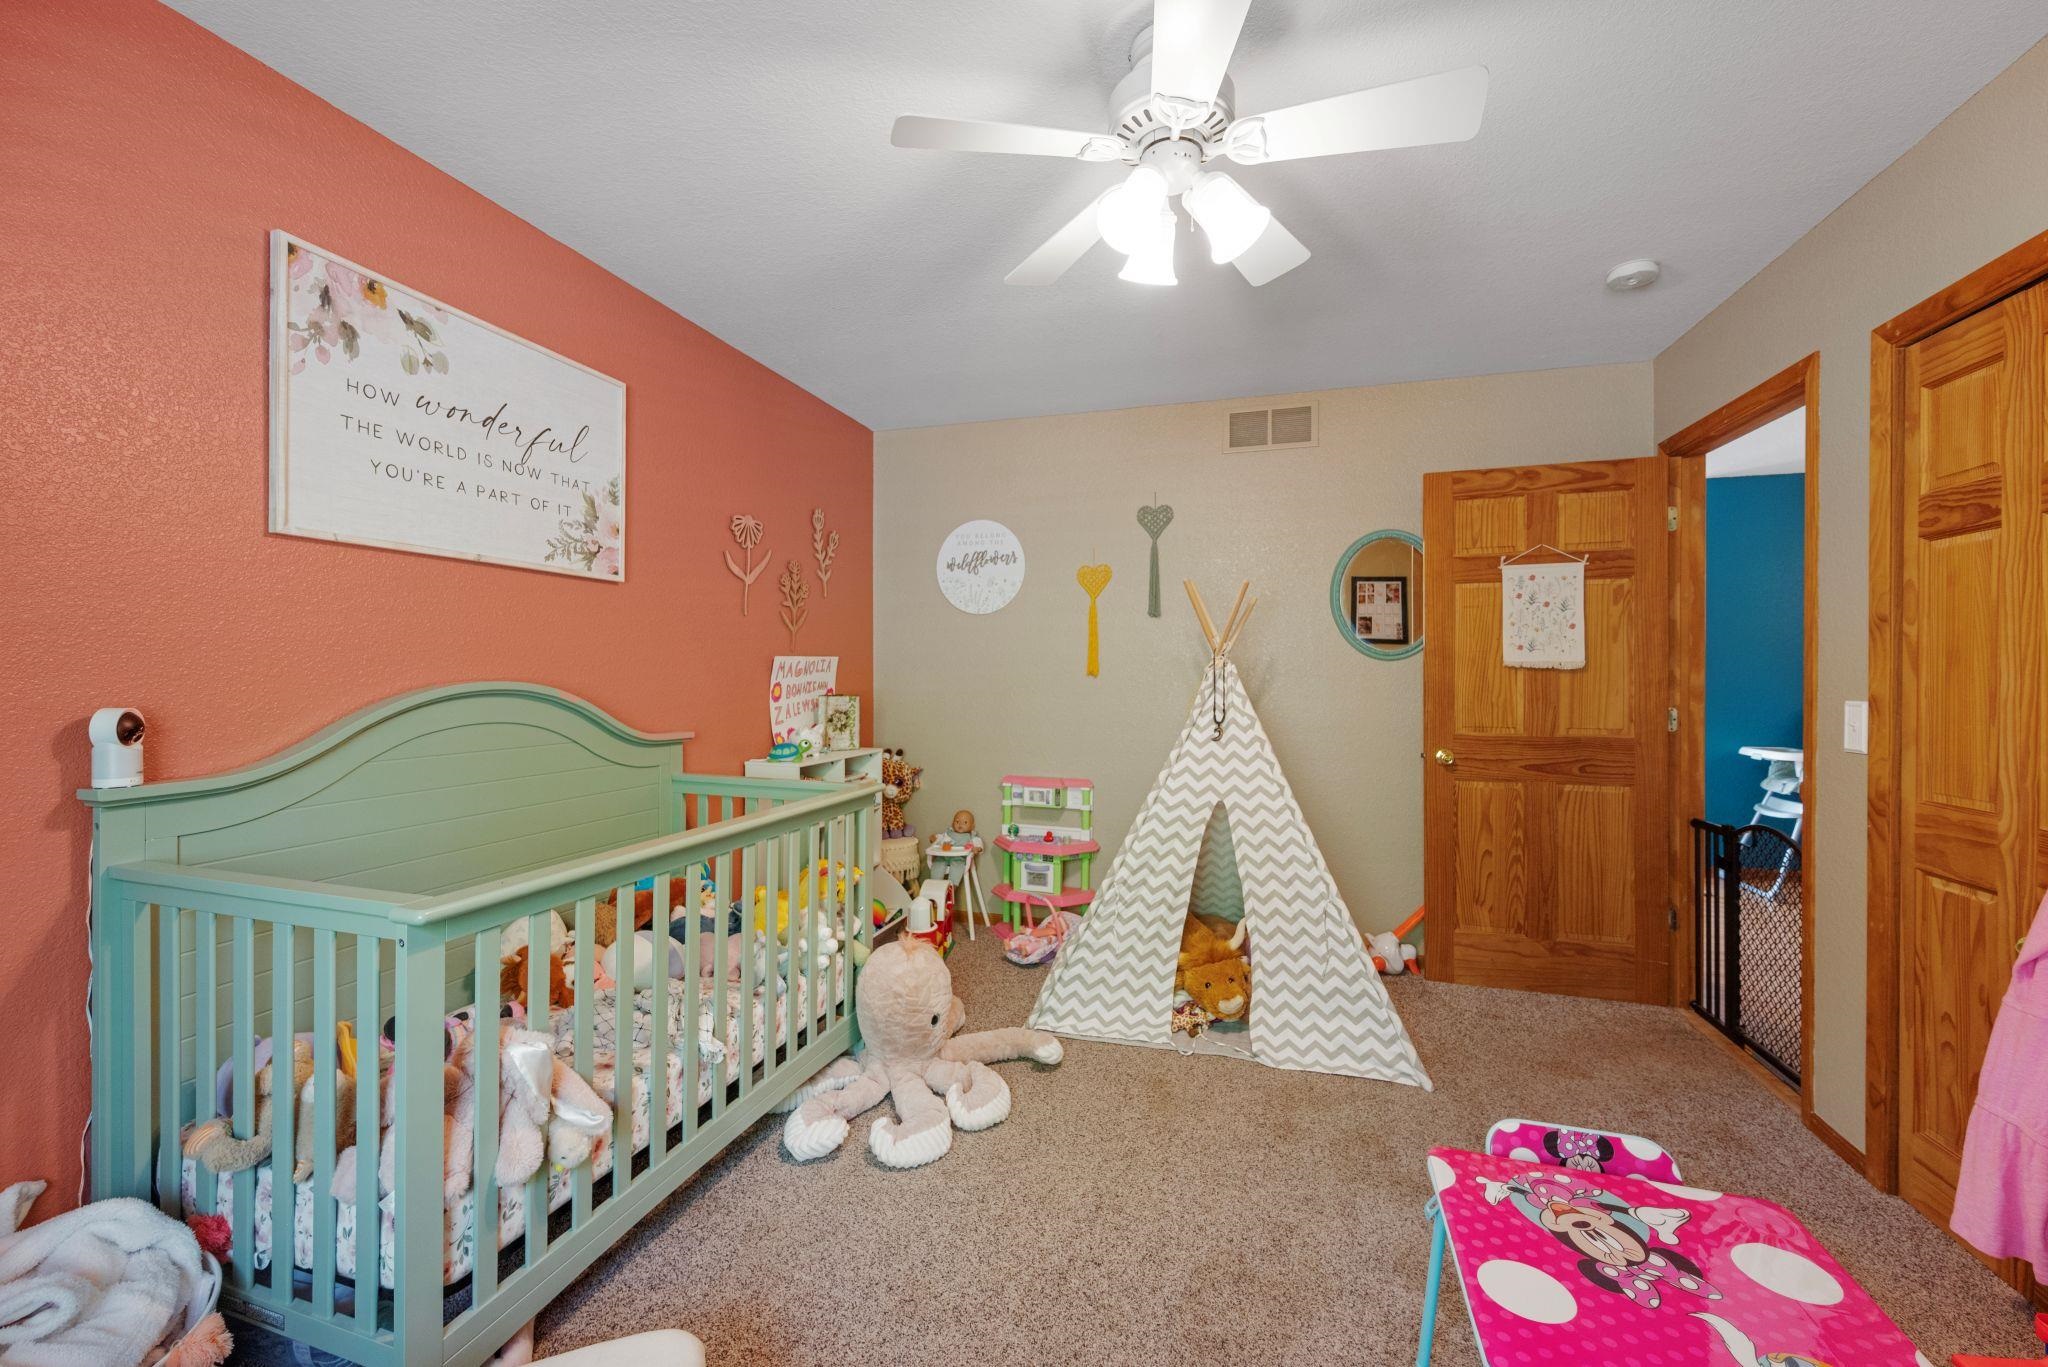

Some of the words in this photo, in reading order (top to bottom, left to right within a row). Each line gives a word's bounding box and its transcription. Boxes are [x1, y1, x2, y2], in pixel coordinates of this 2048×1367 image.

[346, 378, 401, 407] HOW
[416, 394, 590, 463] wonderful
[341, 414, 383, 440] THE
[396, 428, 467, 461] WORLD
[477, 452, 493, 468] IS
[502, 459, 541, 480] NOW
[550, 472, 591, 491] THAT
[370, 459, 446, 490] YOU'RE
[456, 481, 467, 495] A
[476, 485, 521, 507] PART
[530, 497, 550, 513] OF
[557, 504, 572, 517] IT
[946, 550, 1018, 575] wildflowers
[776, 659, 832, 681] MAGNOLIA
